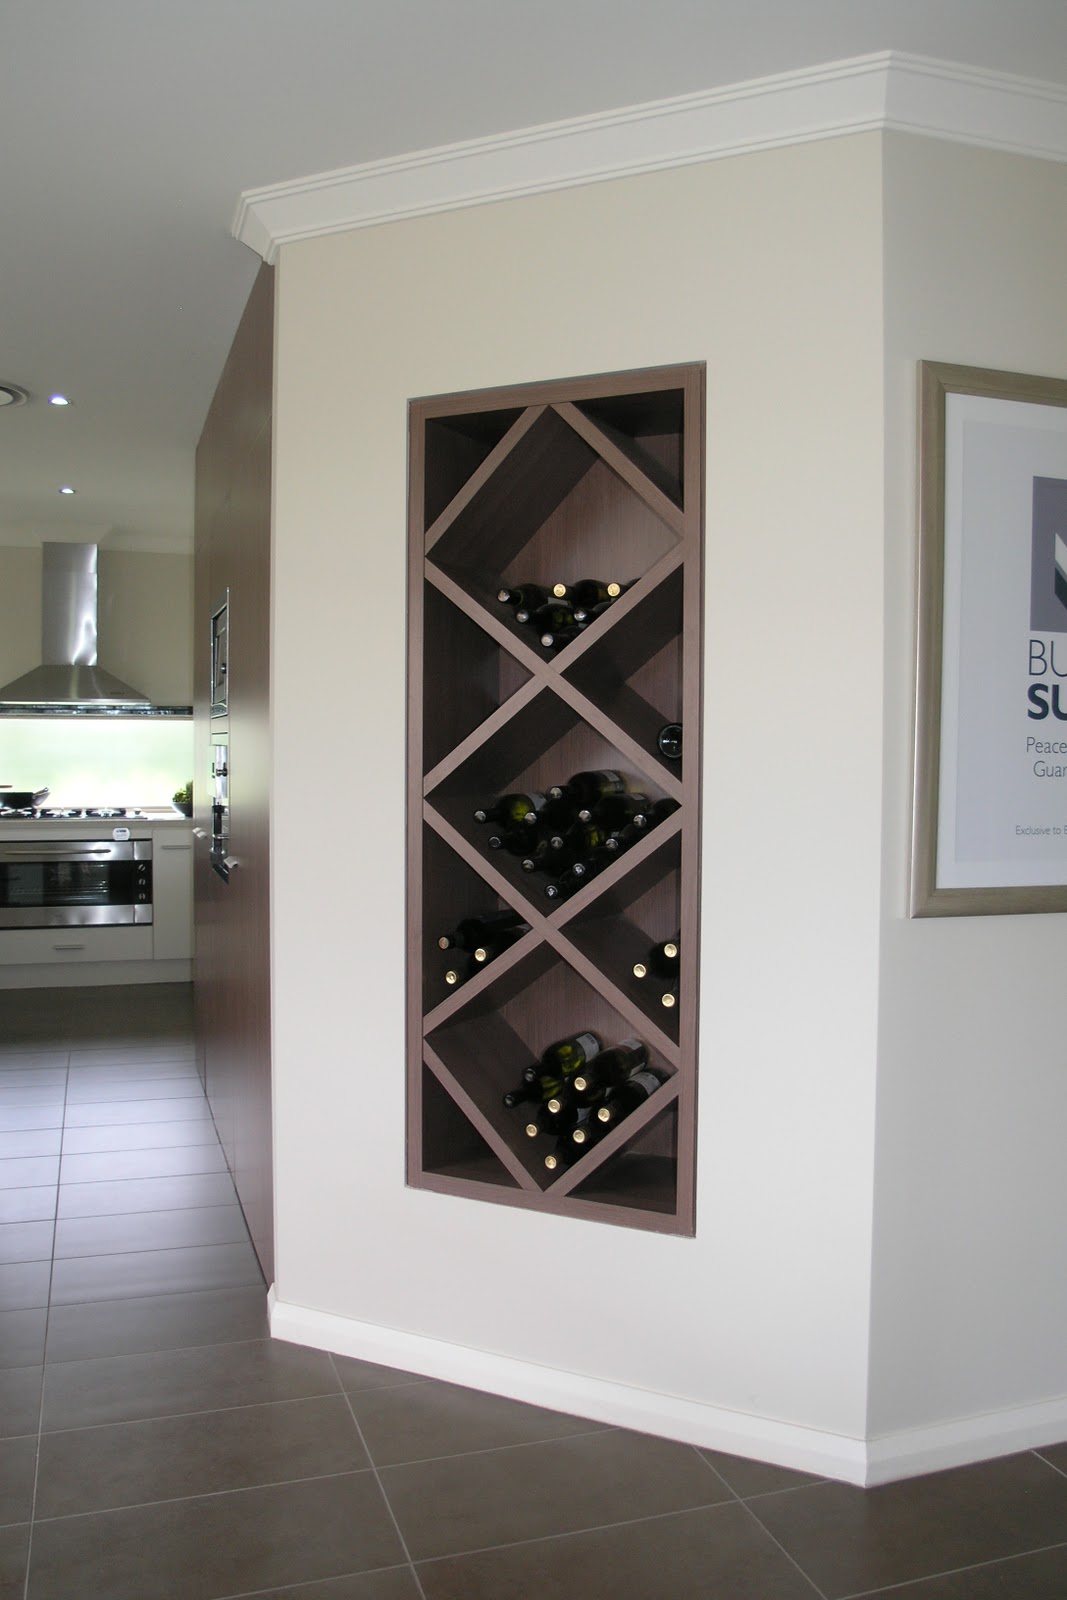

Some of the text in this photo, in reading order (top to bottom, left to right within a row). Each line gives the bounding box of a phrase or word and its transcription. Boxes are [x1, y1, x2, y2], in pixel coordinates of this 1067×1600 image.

[1026, 736, 1067, 754] Peace
[1015, 825, 1051, 835] Exclusive
[1053, 826, 1062, 835] to
